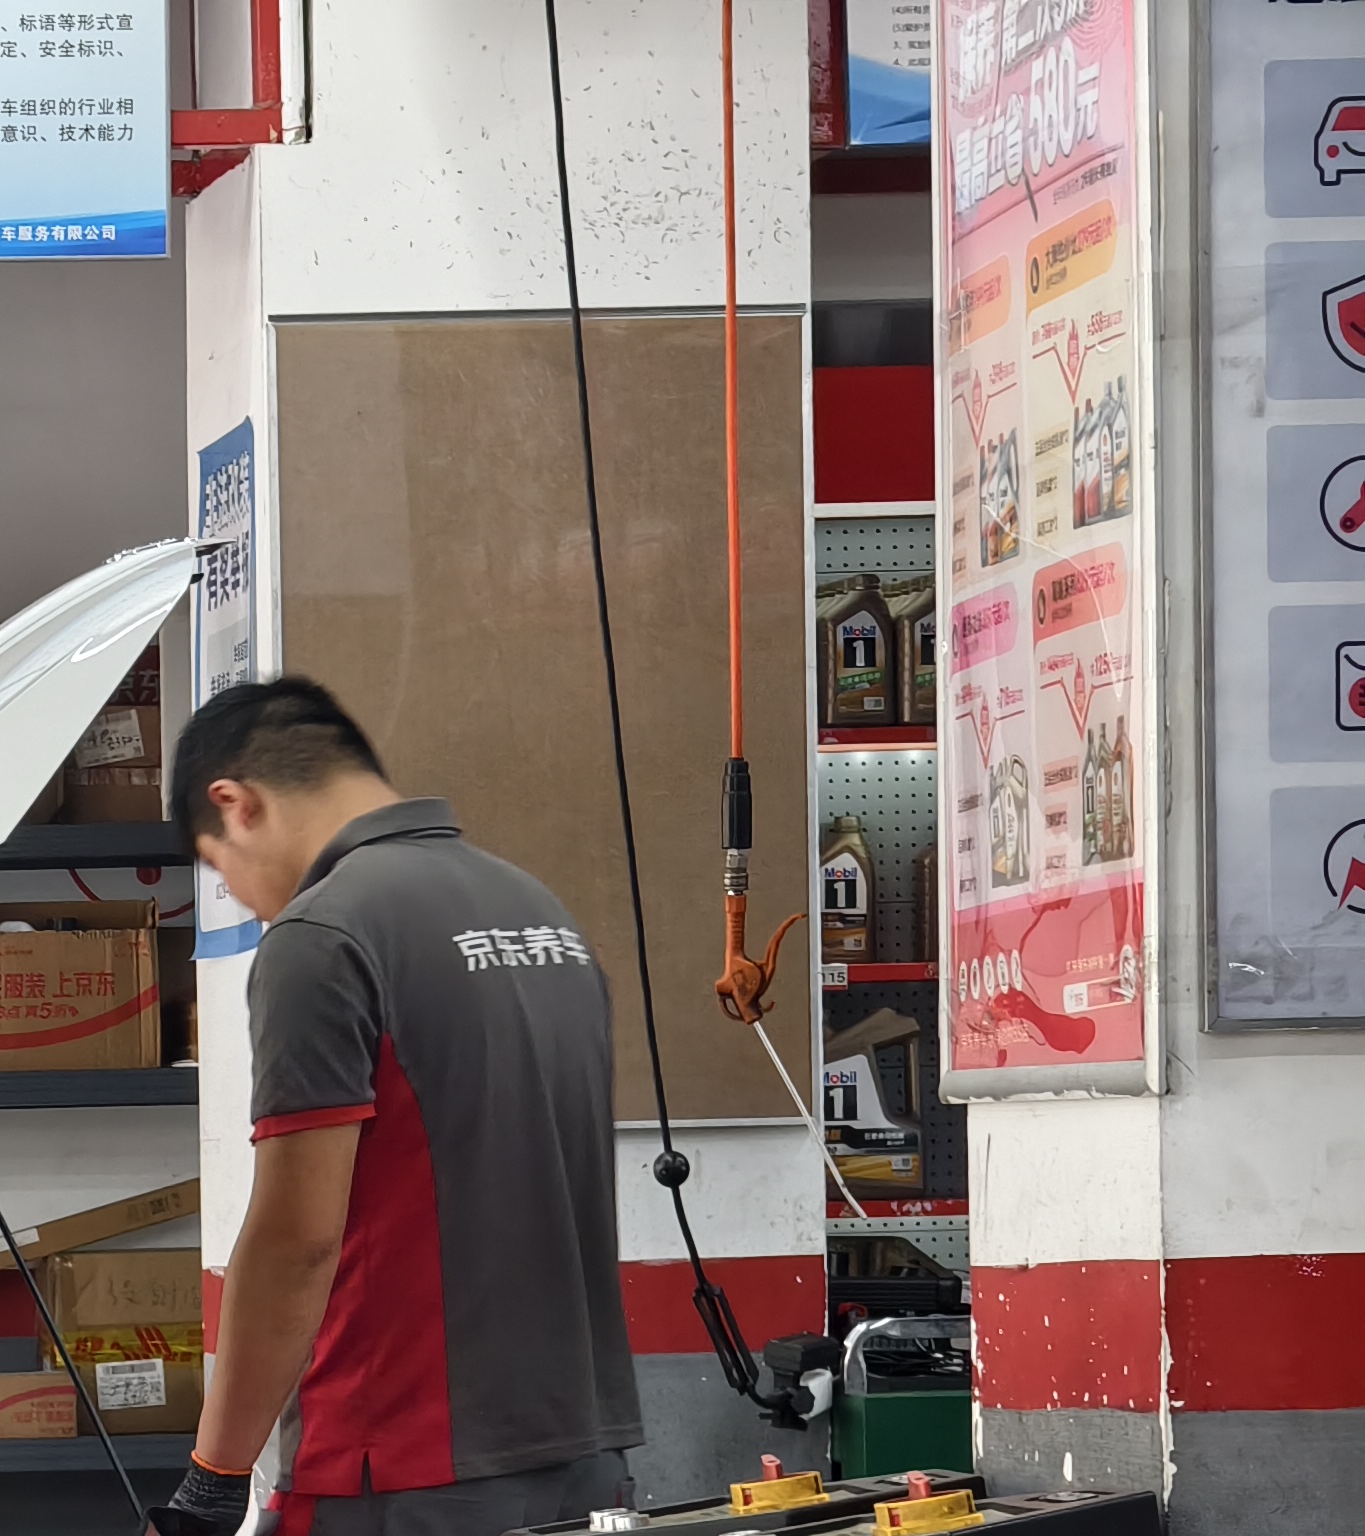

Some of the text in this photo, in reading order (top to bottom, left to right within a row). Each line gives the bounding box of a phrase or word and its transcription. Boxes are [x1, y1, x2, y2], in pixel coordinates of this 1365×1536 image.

[842, 625, 876, 637] Mobil
[853, 640, 865, 667] 1
[824, 867, 857, 878] Mobil
[833, 881, 846, 908] 1
[452, 925, 591, 972] 京东养车
[52, 970, 116, 998] 上京东
[829, 1087, 844, 1119] 1
